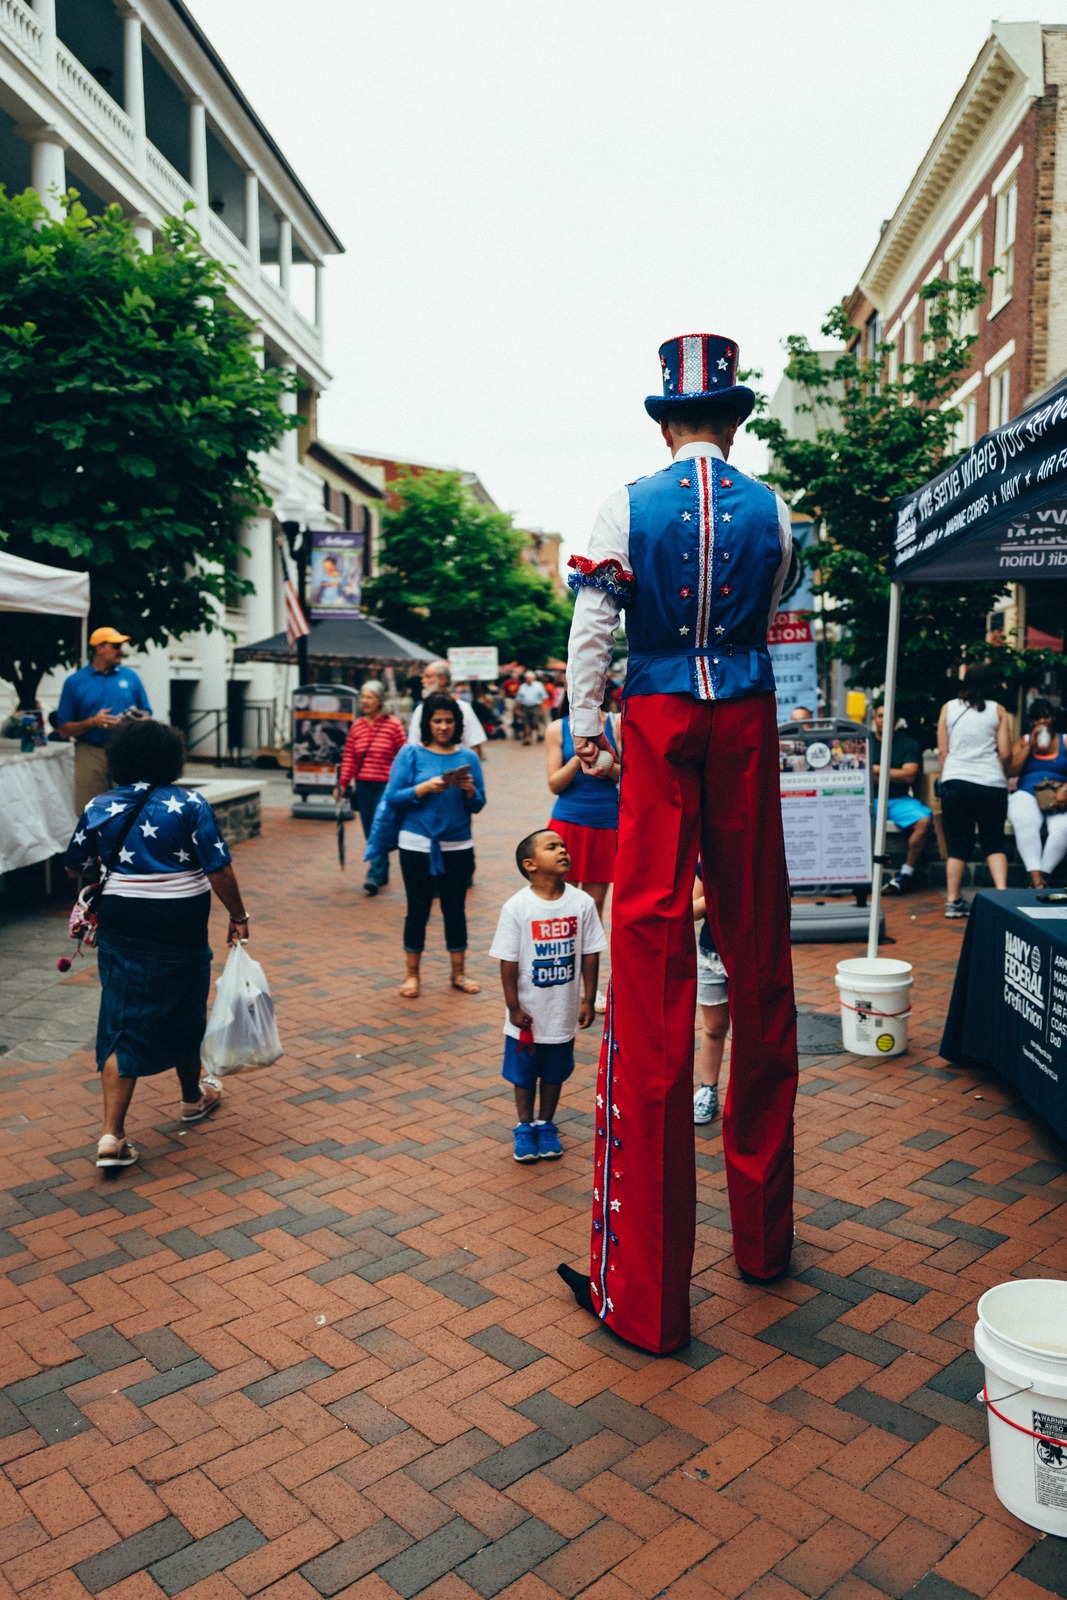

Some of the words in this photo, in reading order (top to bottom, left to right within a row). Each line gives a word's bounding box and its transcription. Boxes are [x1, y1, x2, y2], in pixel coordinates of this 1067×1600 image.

[933, 469, 961, 512] serve
[961, 447, 998, 490] where
[996, 420, 1026, 475] you
[967, 494, 990, 524] CORPS
[1000, 473, 1022, 504] NAVY
[1037, 454, 1057, 483] AIR
[540, 921, 571, 938] RED
[534, 939, 575, 957] WHITE
[1005, 930, 1031, 965] NAVY
[537, 964, 573, 983] DUDE
[1004, 952, 1044, 1001] FEDERAL
[1022, 997, 1043, 1031] Union
[1044, 1422, 1064, 1433] AVISO
